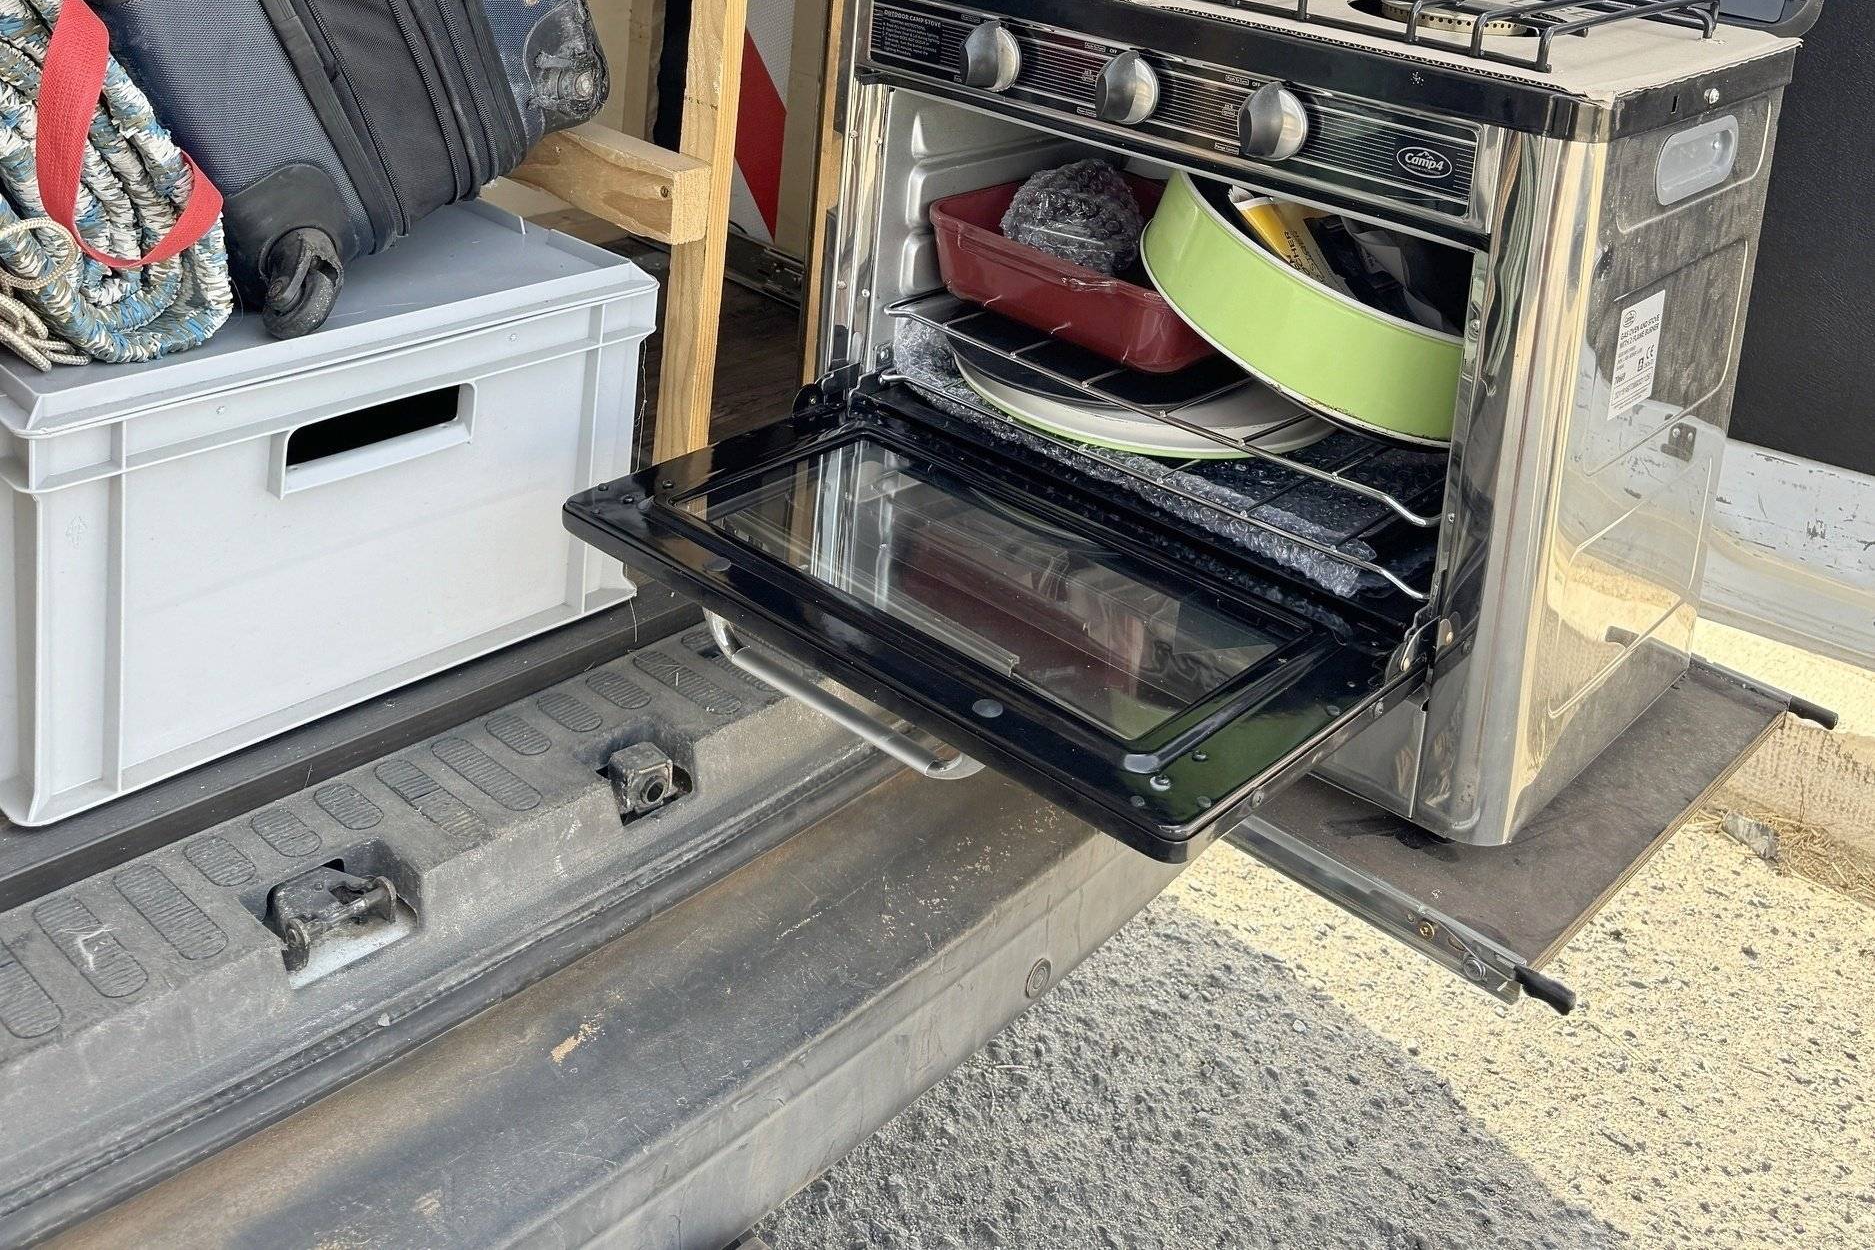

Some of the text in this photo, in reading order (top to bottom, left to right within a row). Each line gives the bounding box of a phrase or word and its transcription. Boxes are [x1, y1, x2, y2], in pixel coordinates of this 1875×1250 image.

[884, 9, 941, 28] OUTDOOR CAMP STOVE
[1405, 152, 1444, 171] Camp4
